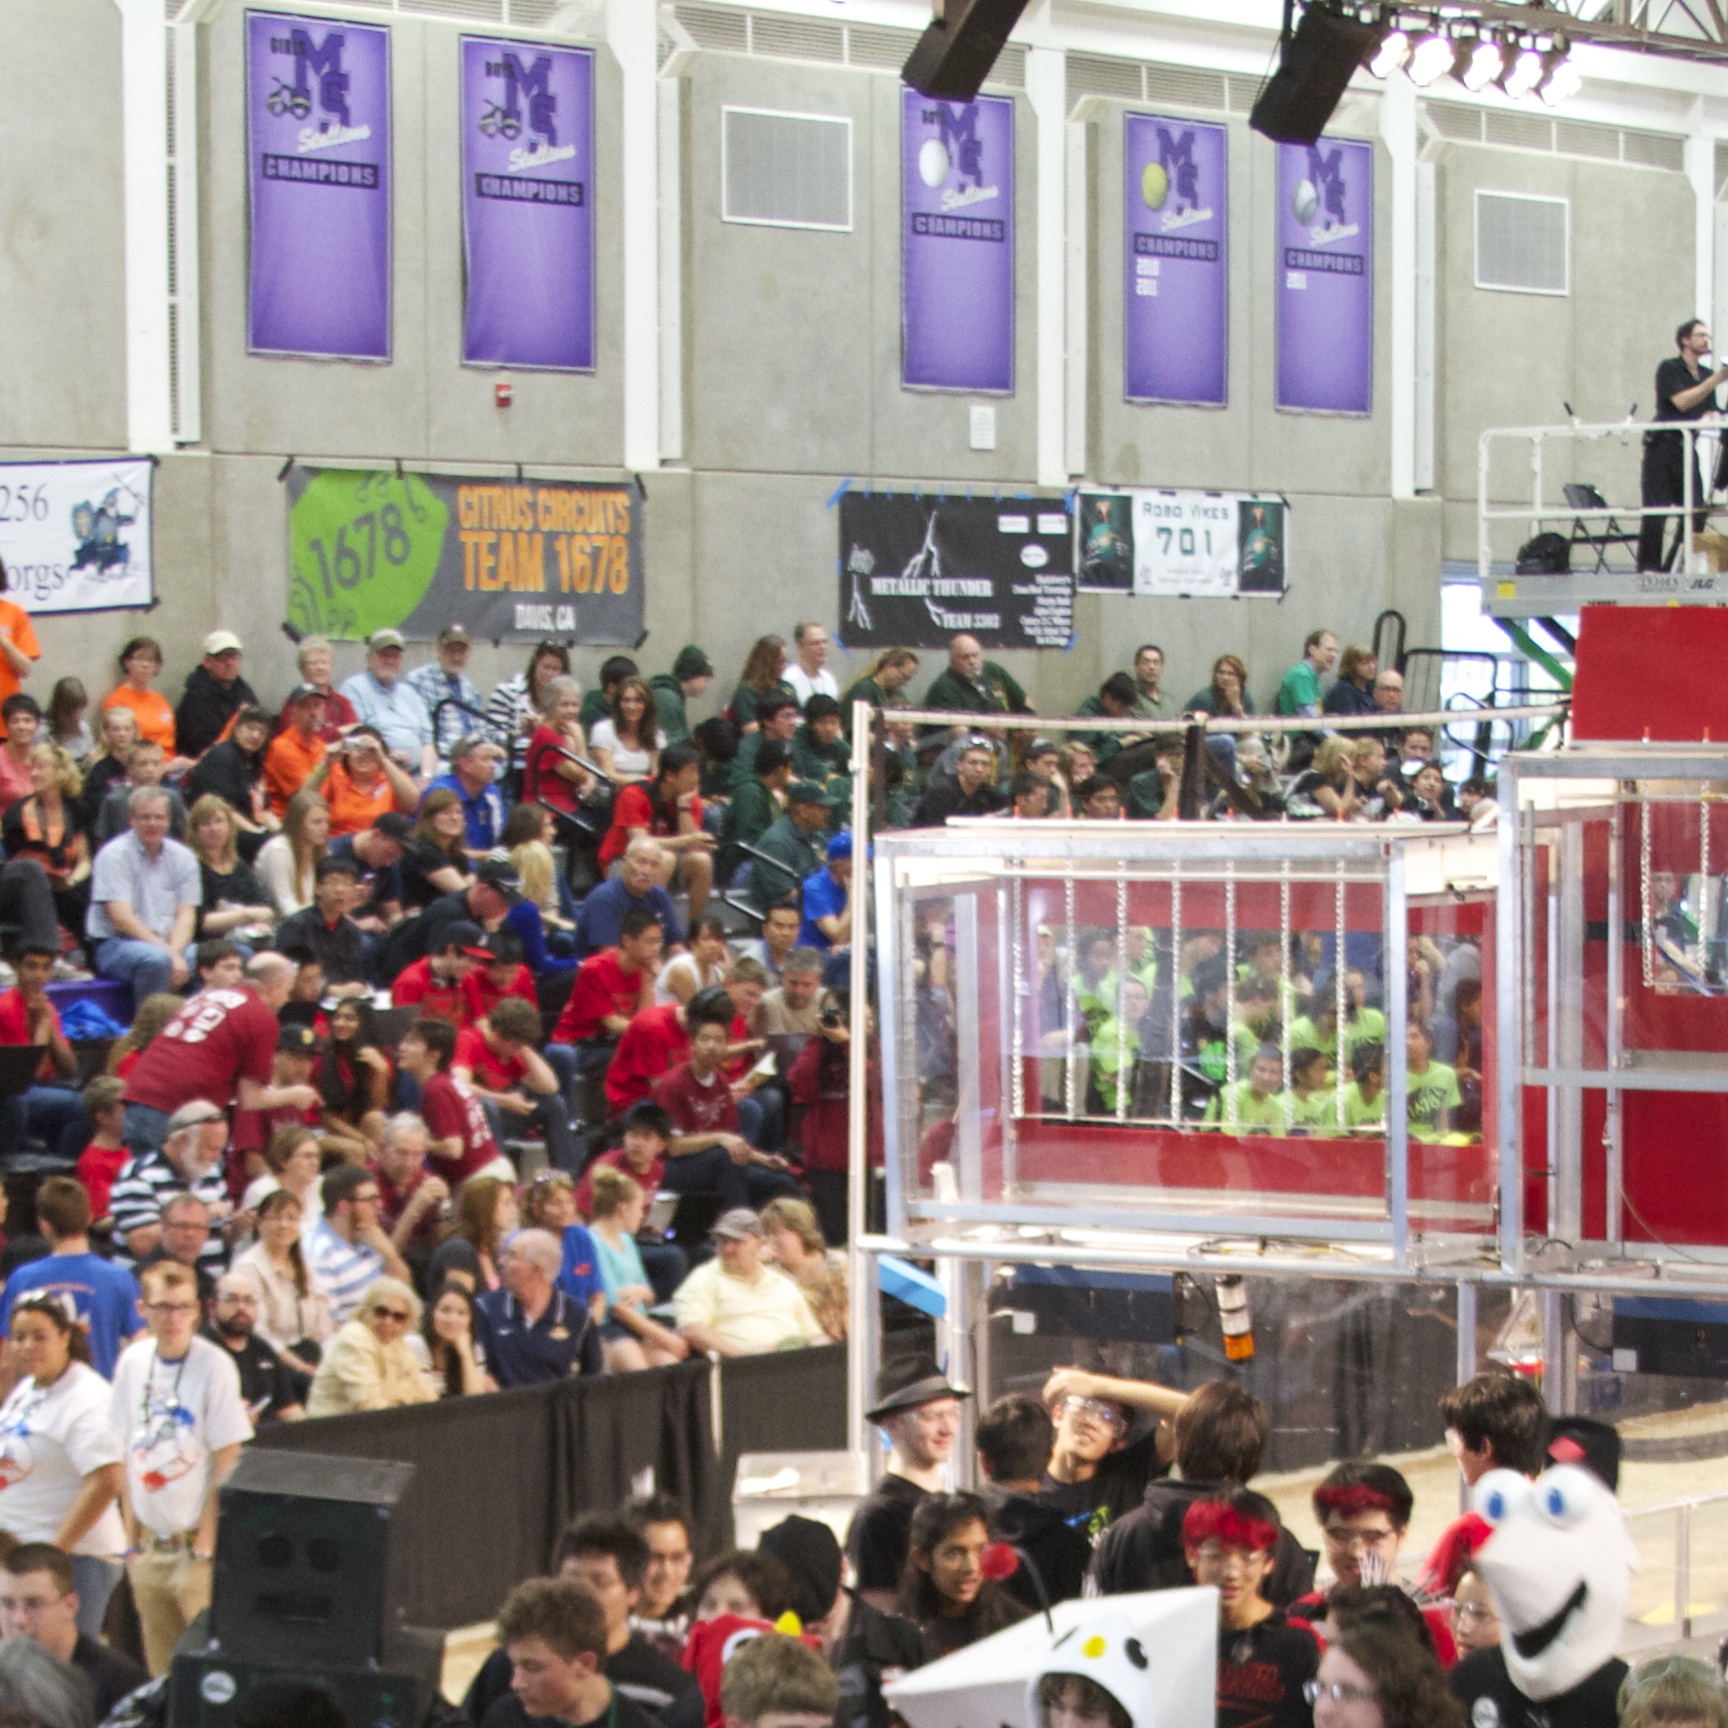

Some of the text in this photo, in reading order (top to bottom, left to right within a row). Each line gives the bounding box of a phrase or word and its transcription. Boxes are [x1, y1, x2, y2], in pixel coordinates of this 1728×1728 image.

[265, 159, 375, 186] CHAMPIONS
[480, 177, 580, 204] CHAMPIONS
[914, 216, 1003, 240] CHAMPIONS
[1136, 236, 1217, 259] CHAMPIONS
[1287, 251, 1363, 273] CHAMPIONS
[458, 485, 631, 534] CITRUS CIRCUITS
[1143, 502, 1229, 520] ROBO VIKES
[309, 502, 411, 601] 1678
[1157, 526, 1212, 556] 701
[459, 530, 629, 595] TEAM 1678
[871, 578, 931, 597] METALLIC
[934, 578, 994, 598] THUNDER
[514, 603, 576, 632] DAVIS, CA
[942, 612, 972, 630] TEAM
